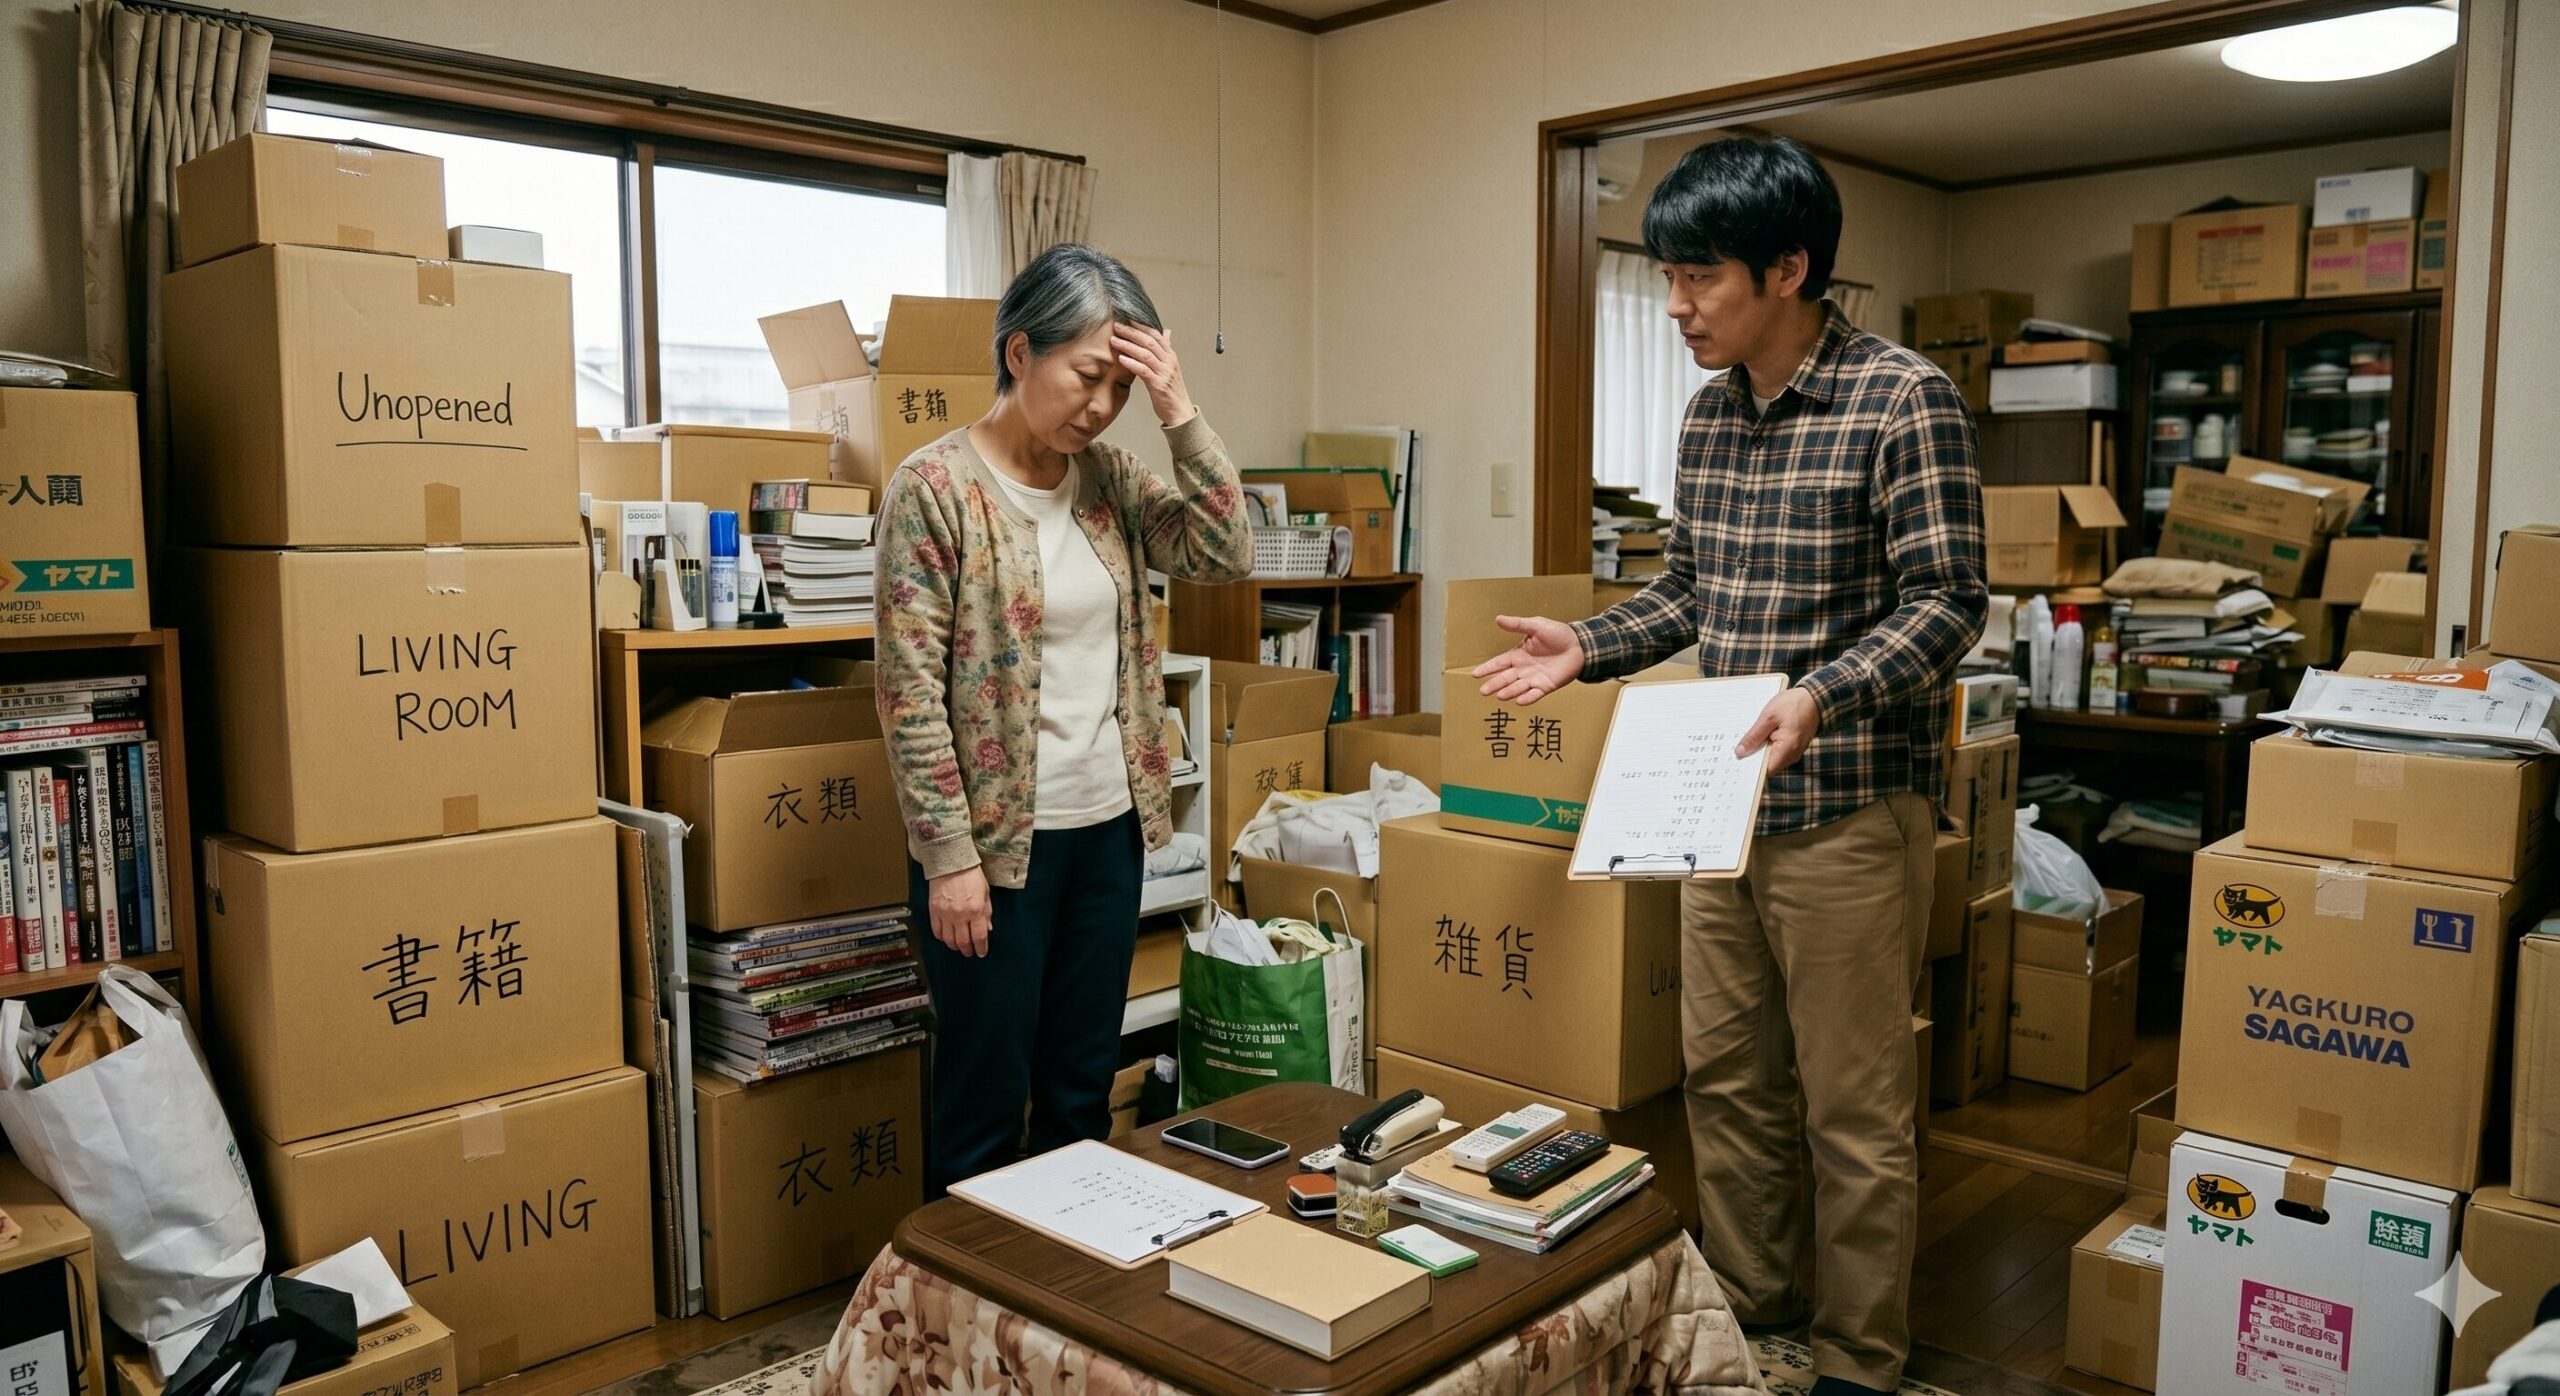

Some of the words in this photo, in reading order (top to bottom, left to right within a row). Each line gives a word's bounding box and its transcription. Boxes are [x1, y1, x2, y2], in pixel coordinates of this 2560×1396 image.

[338, 371, 514, 440] Unopened
[44, 564, 121, 588] ヤマト
[359, 628, 518, 677] LIVING
[396, 688, 517, 741] ROOM
[1484, 708, 1564, 763] 書類
[764, 776, 863, 830] 衣類
[1434, 914, 1534, 1000] 雑貨
[2213, 926, 2284, 956] ヤマト
[361, 918, 529, 1026] 書籍
[2247, 985, 2415, 1035] YAGKURO
[2243, 1012, 2411, 1069] SAGAWA
[777, 1117, 903, 1207] 衣類
[399, 1178, 598, 1288] LIVING
[2186, 1214, 2256, 1247] ヤマト
